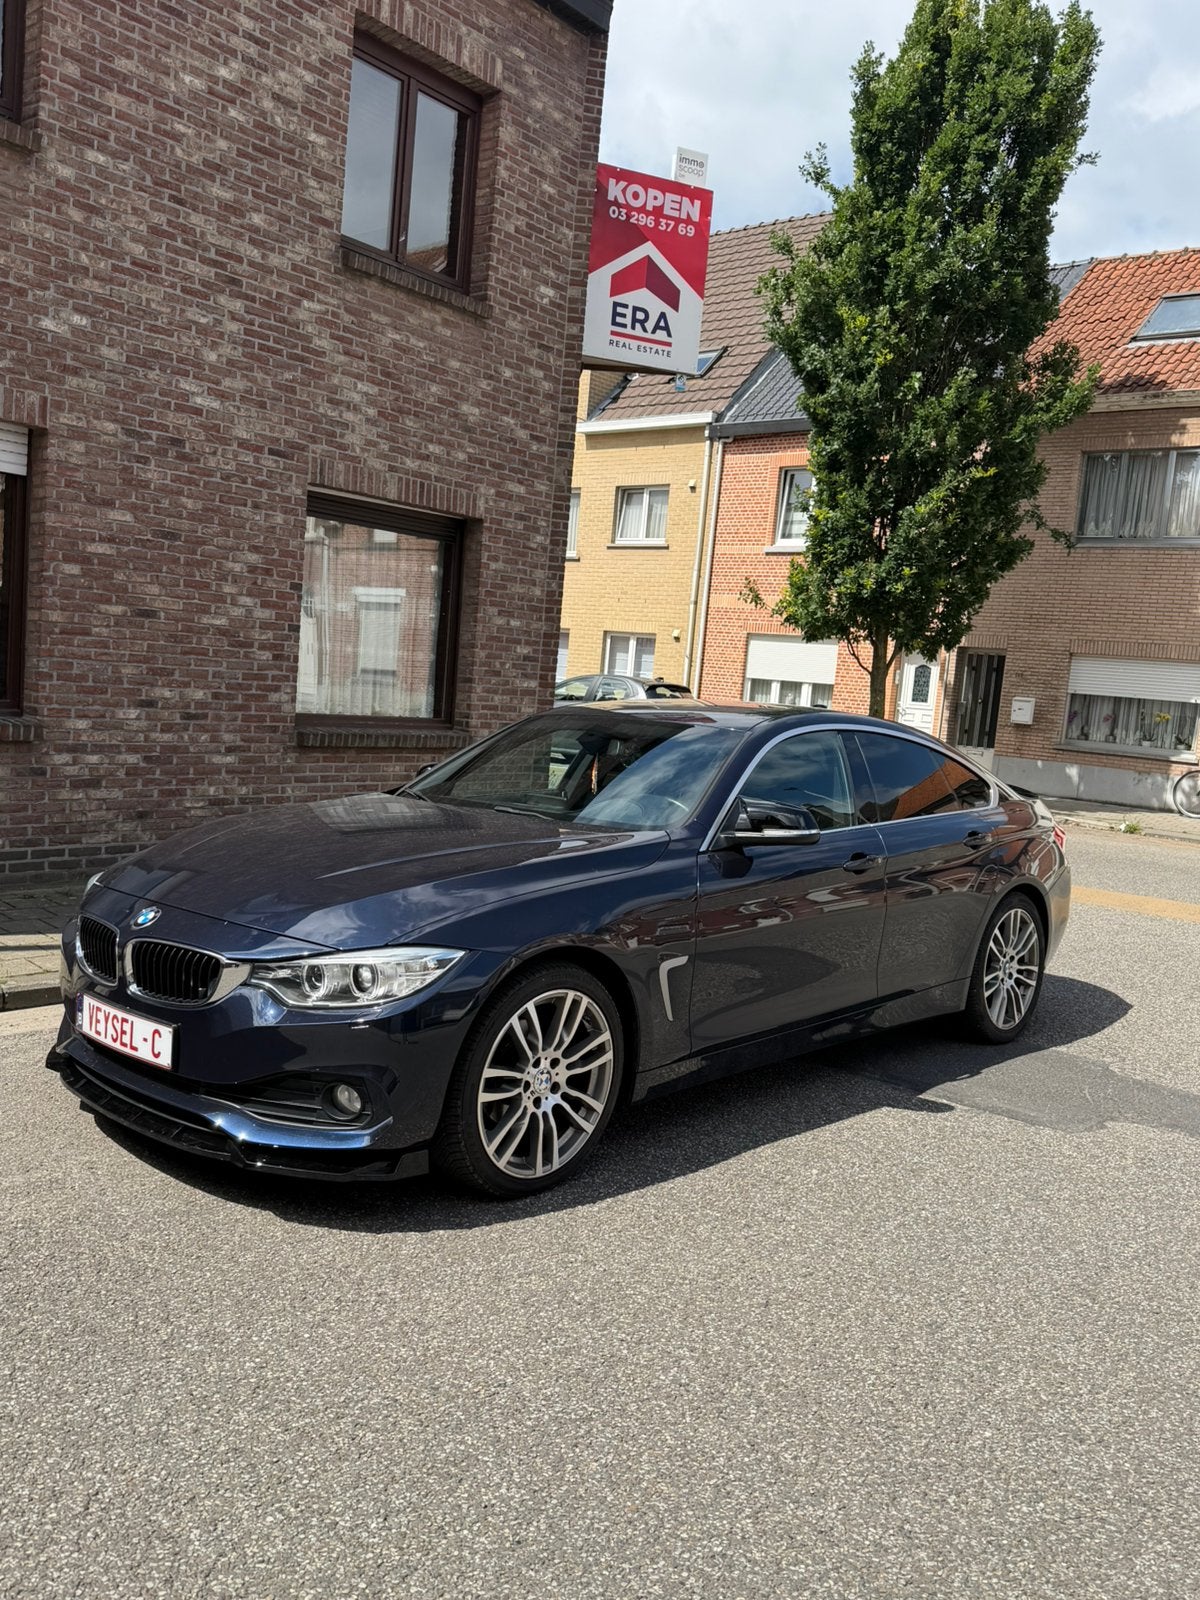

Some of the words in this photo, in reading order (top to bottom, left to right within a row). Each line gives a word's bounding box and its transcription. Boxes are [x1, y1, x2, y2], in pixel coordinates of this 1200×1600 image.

[678, 164, 704, 178] scoop
[607, 177, 702, 223] KOPEN
[609, 205, 627, 221] 03
[629, 211, 656, 228] 296
[658, 218, 675, 232] 37
[677, 223, 696, 237] 69
[610, 300, 673, 339] ERA
[608, 339, 633, 351] REAL
[636, 344, 672, 358] ESTATE
